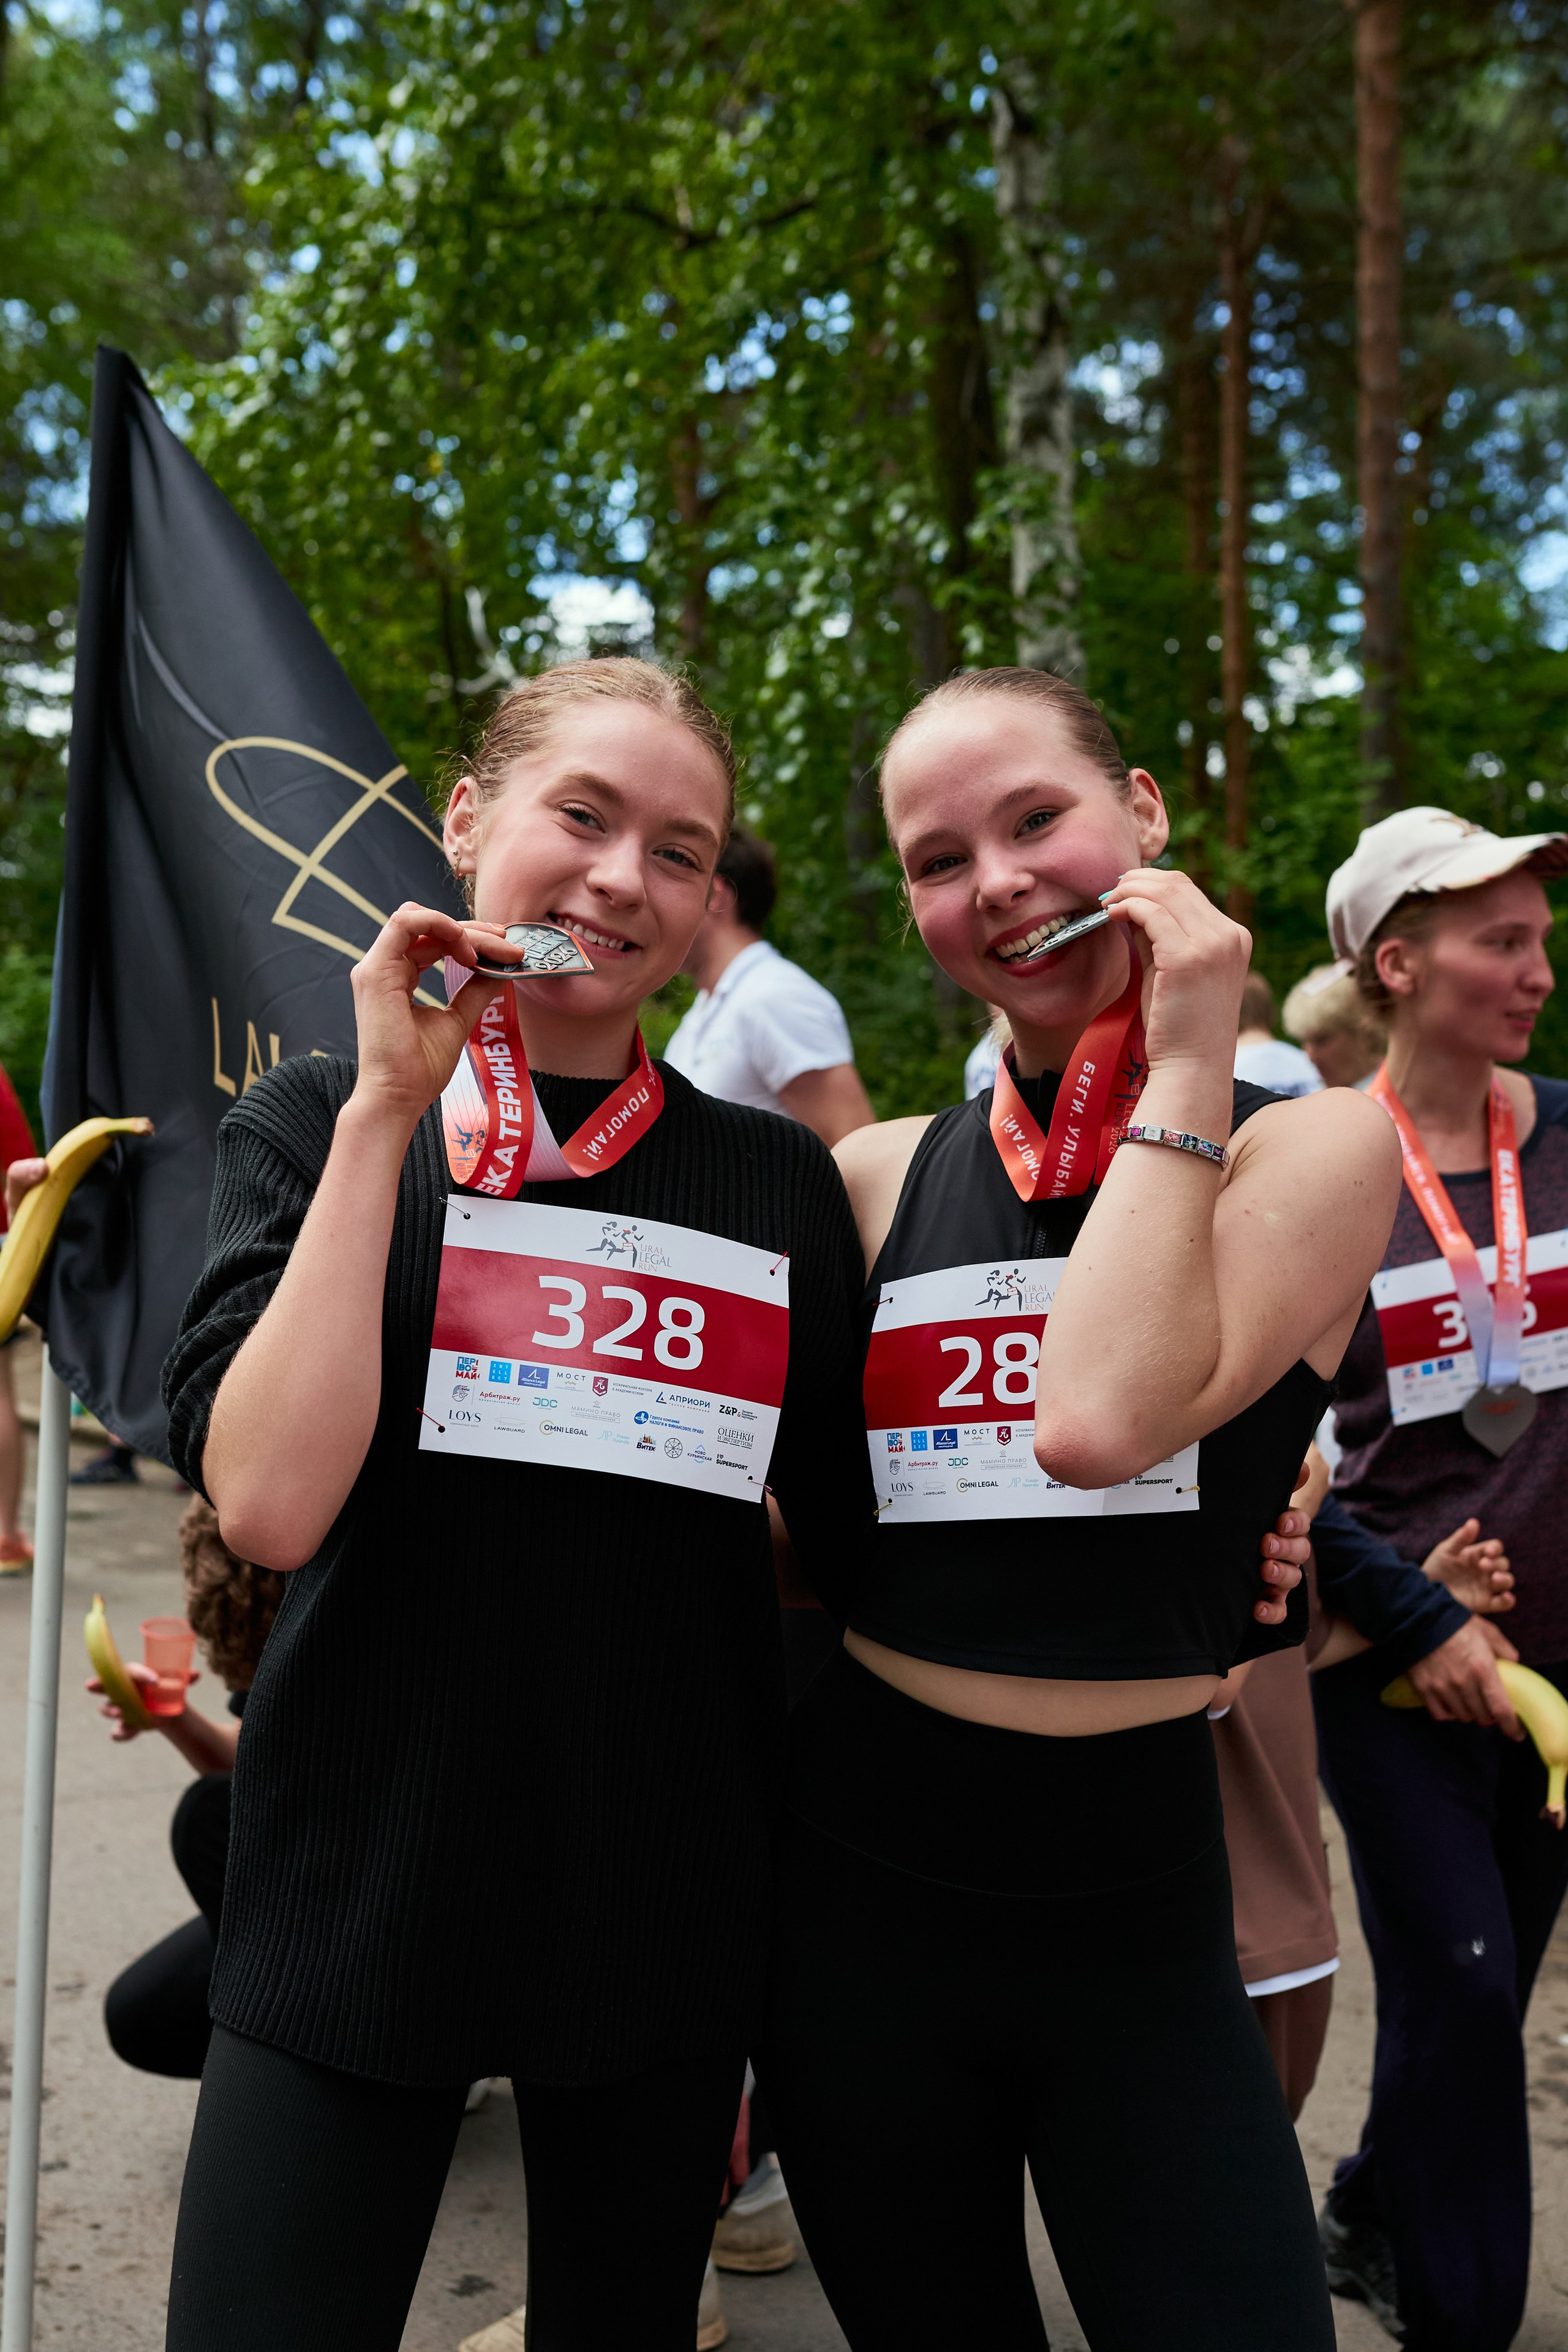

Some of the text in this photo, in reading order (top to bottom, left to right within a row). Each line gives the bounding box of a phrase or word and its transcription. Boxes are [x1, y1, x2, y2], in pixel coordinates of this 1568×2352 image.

[535, 945, 578, 971] 2026
[582, 1087, 650, 1161] ПОМОГАЙ!
[1047, 1061, 1095, 1199] БЕГИ. УЛЫБАЙ
[641, 1244, 663, 1255] URAL
[639, 1252, 672, 1267] LEGAL
[638, 1262, 657, 1272] RUN
[1024, 1284, 1049, 1292] URAL
[1025, 1291, 1054, 1303] LEGA
[531, 1275, 704, 1370] 328
[556, 1372, 586, 1381] МОСТ
[480, 1391, 520, 1402] Арбитраж.ру
[532, 1397, 558, 1408] JDC
[669, 1394, 710, 1408] АПРИОРИ
[449, 1409, 481, 1423] LOYS
[571, 1406, 598, 1414] МАМИНО
[719, 1404, 737, 1416] Z&P
[544, 1424, 588, 1436] OMNI LEGAL
[668, 1423, 692, 1432] ФИНАНСОВОЕ
[718, 1427, 755, 1442] ОЦЕНКИ
[722, 1436, 753, 1447] ЭКСПЕРТИЗЫ
[716, 1459, 748, 1471] SUPERSPORT
[948, 1458, 968, 1466] JDC
[891, 1482, 913, 1493] LOYS
